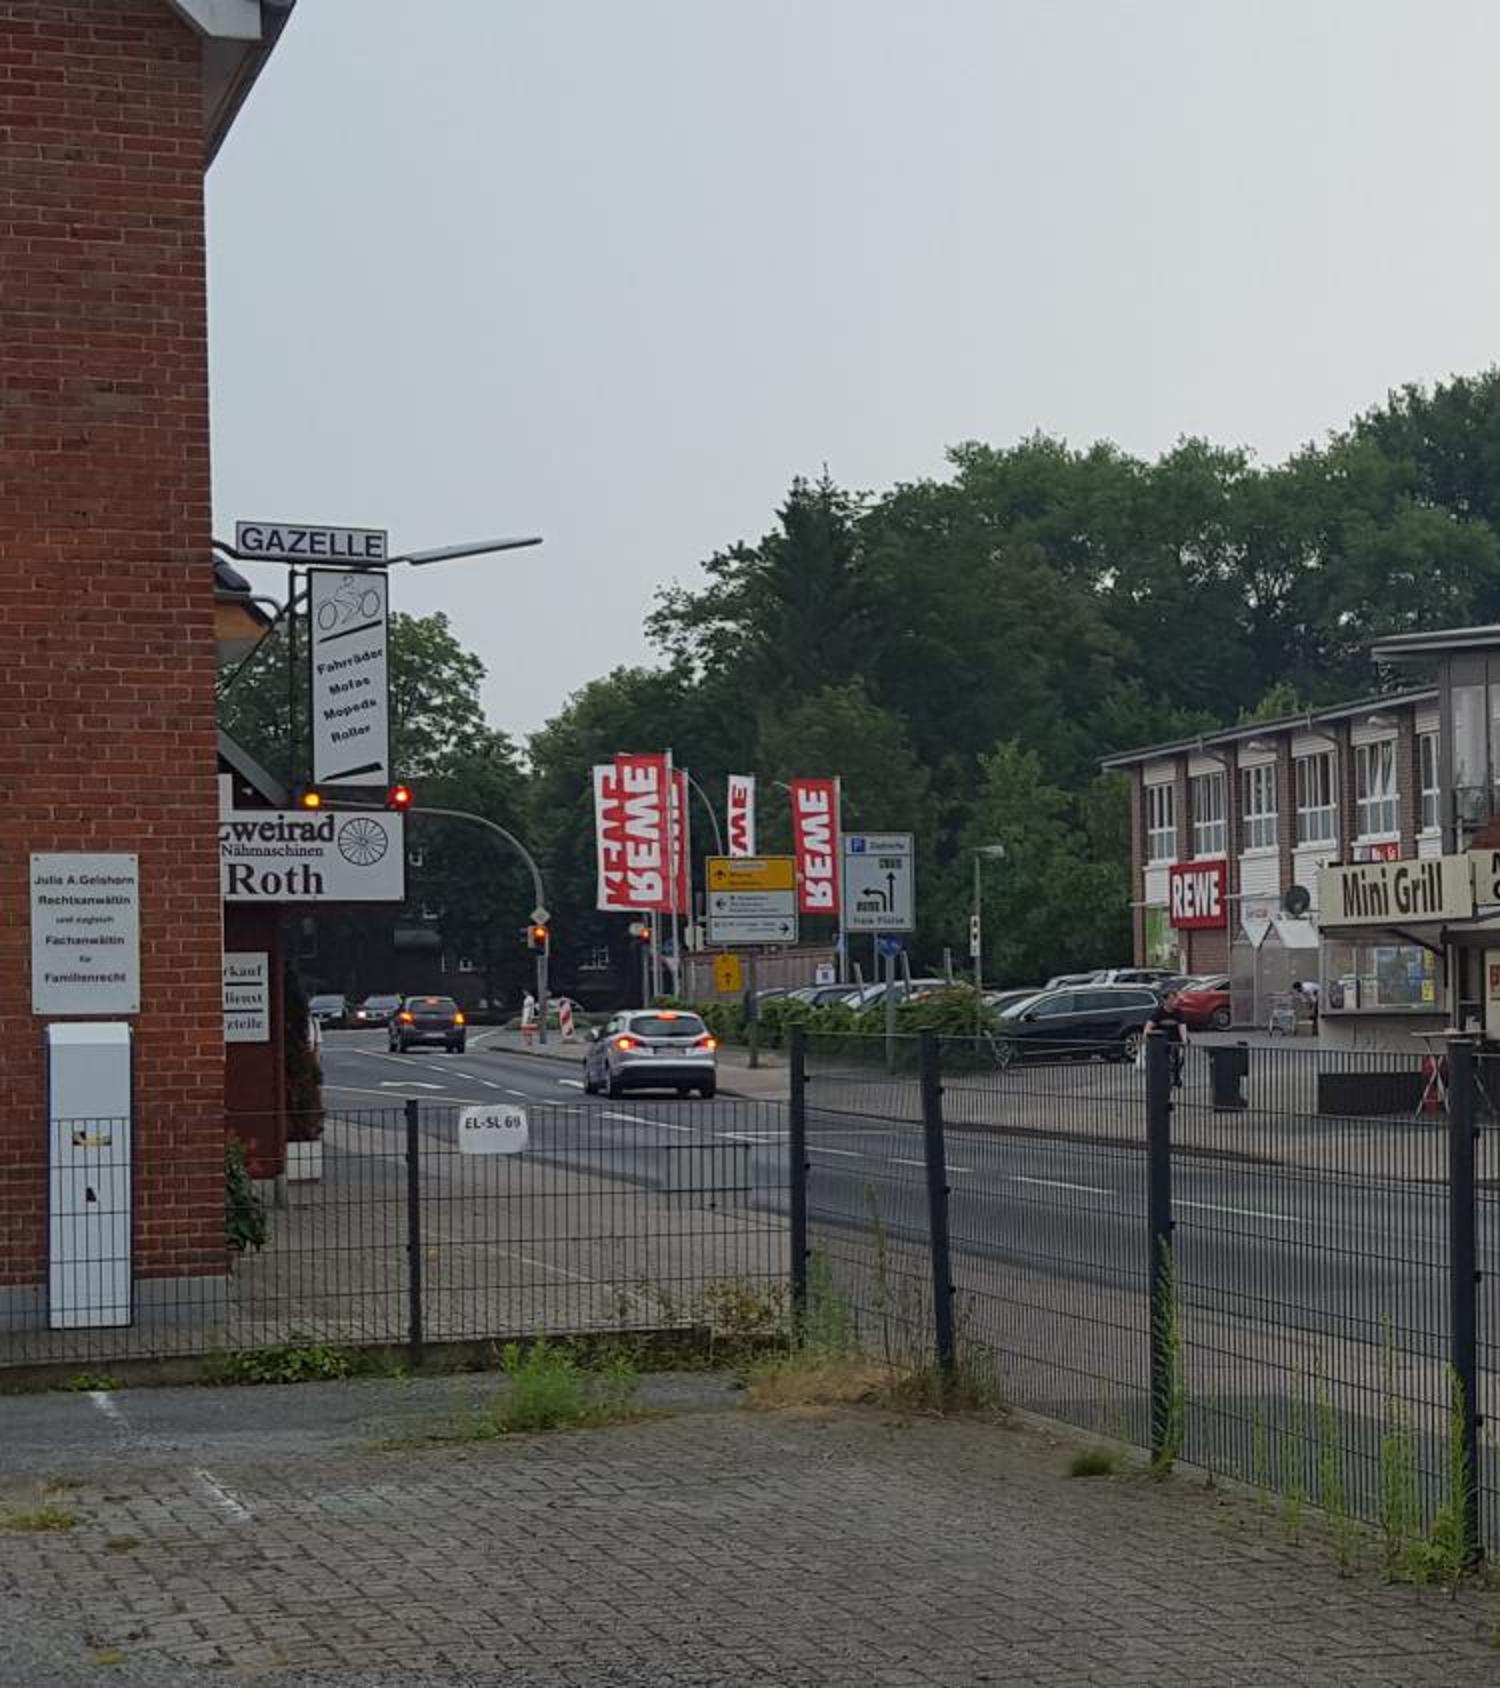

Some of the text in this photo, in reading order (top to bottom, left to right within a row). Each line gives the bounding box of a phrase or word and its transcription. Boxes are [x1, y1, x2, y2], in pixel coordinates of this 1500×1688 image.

[240, 527, 384, 559] GAZELLE
[317, 648, 382, 675] Fahrräder
[323, 699, 377, 720] Mopeds
[331, 724, 371, 743] Roller
[221, 844, 324, 857] Nähmaschinen
[225, 863, 325, 895] Roth
[1342, 862, 1442, 917] Mini Grill
[38, 895, 130, 905] Rechtsanwältin
[1172, 870, 1221, 919] REWE
[45, 935, 125, 945] Fachanwältin
[45, 973, 126, 983] Familienrecht
